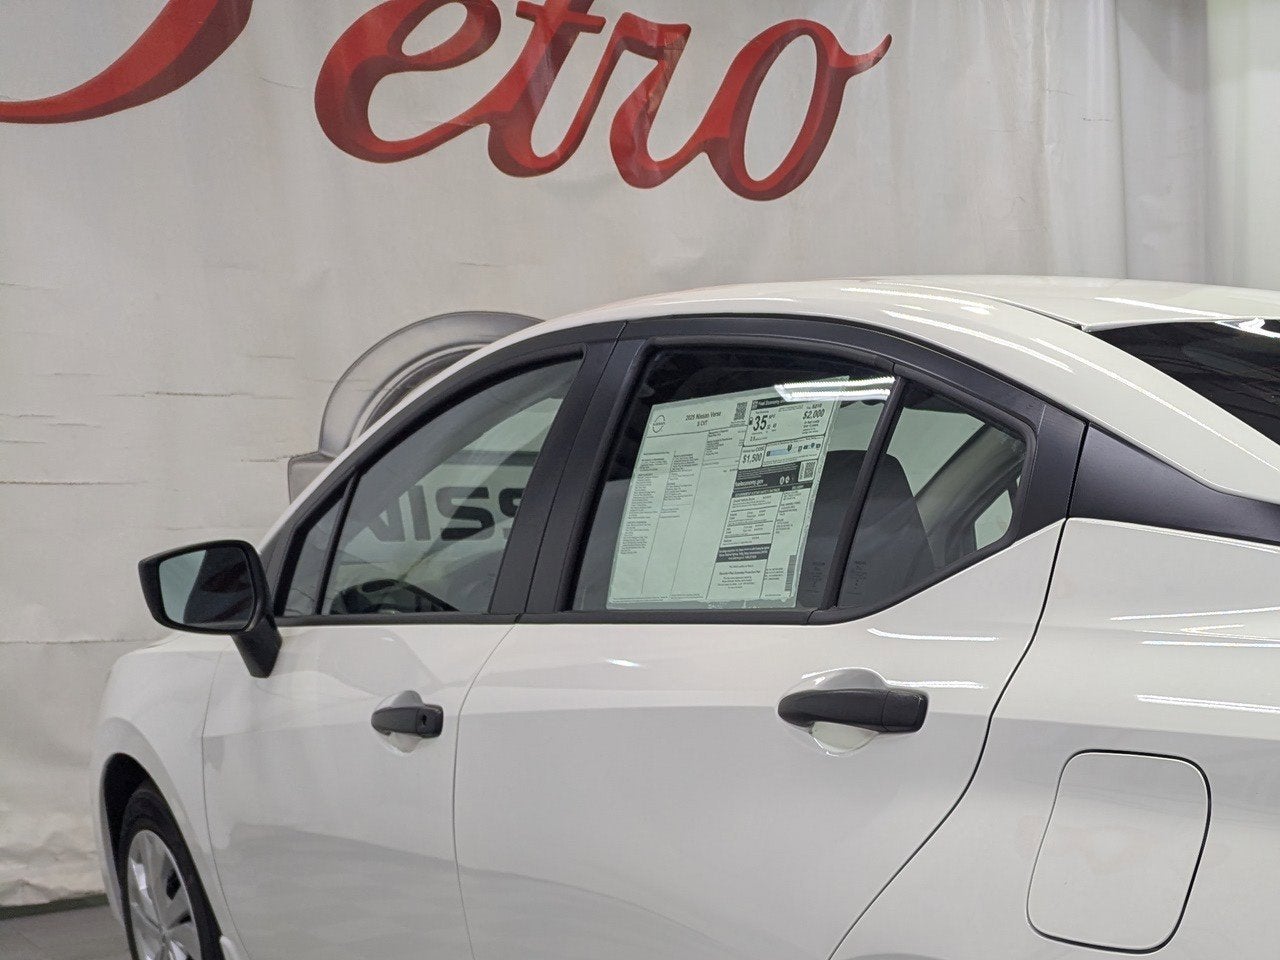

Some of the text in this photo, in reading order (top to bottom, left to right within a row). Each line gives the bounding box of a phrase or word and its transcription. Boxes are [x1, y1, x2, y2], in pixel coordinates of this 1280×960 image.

[0, 0, 893, 201] etro
[753, 415, 768, 431] 35
[743, 453, 763, 464] $1,500
